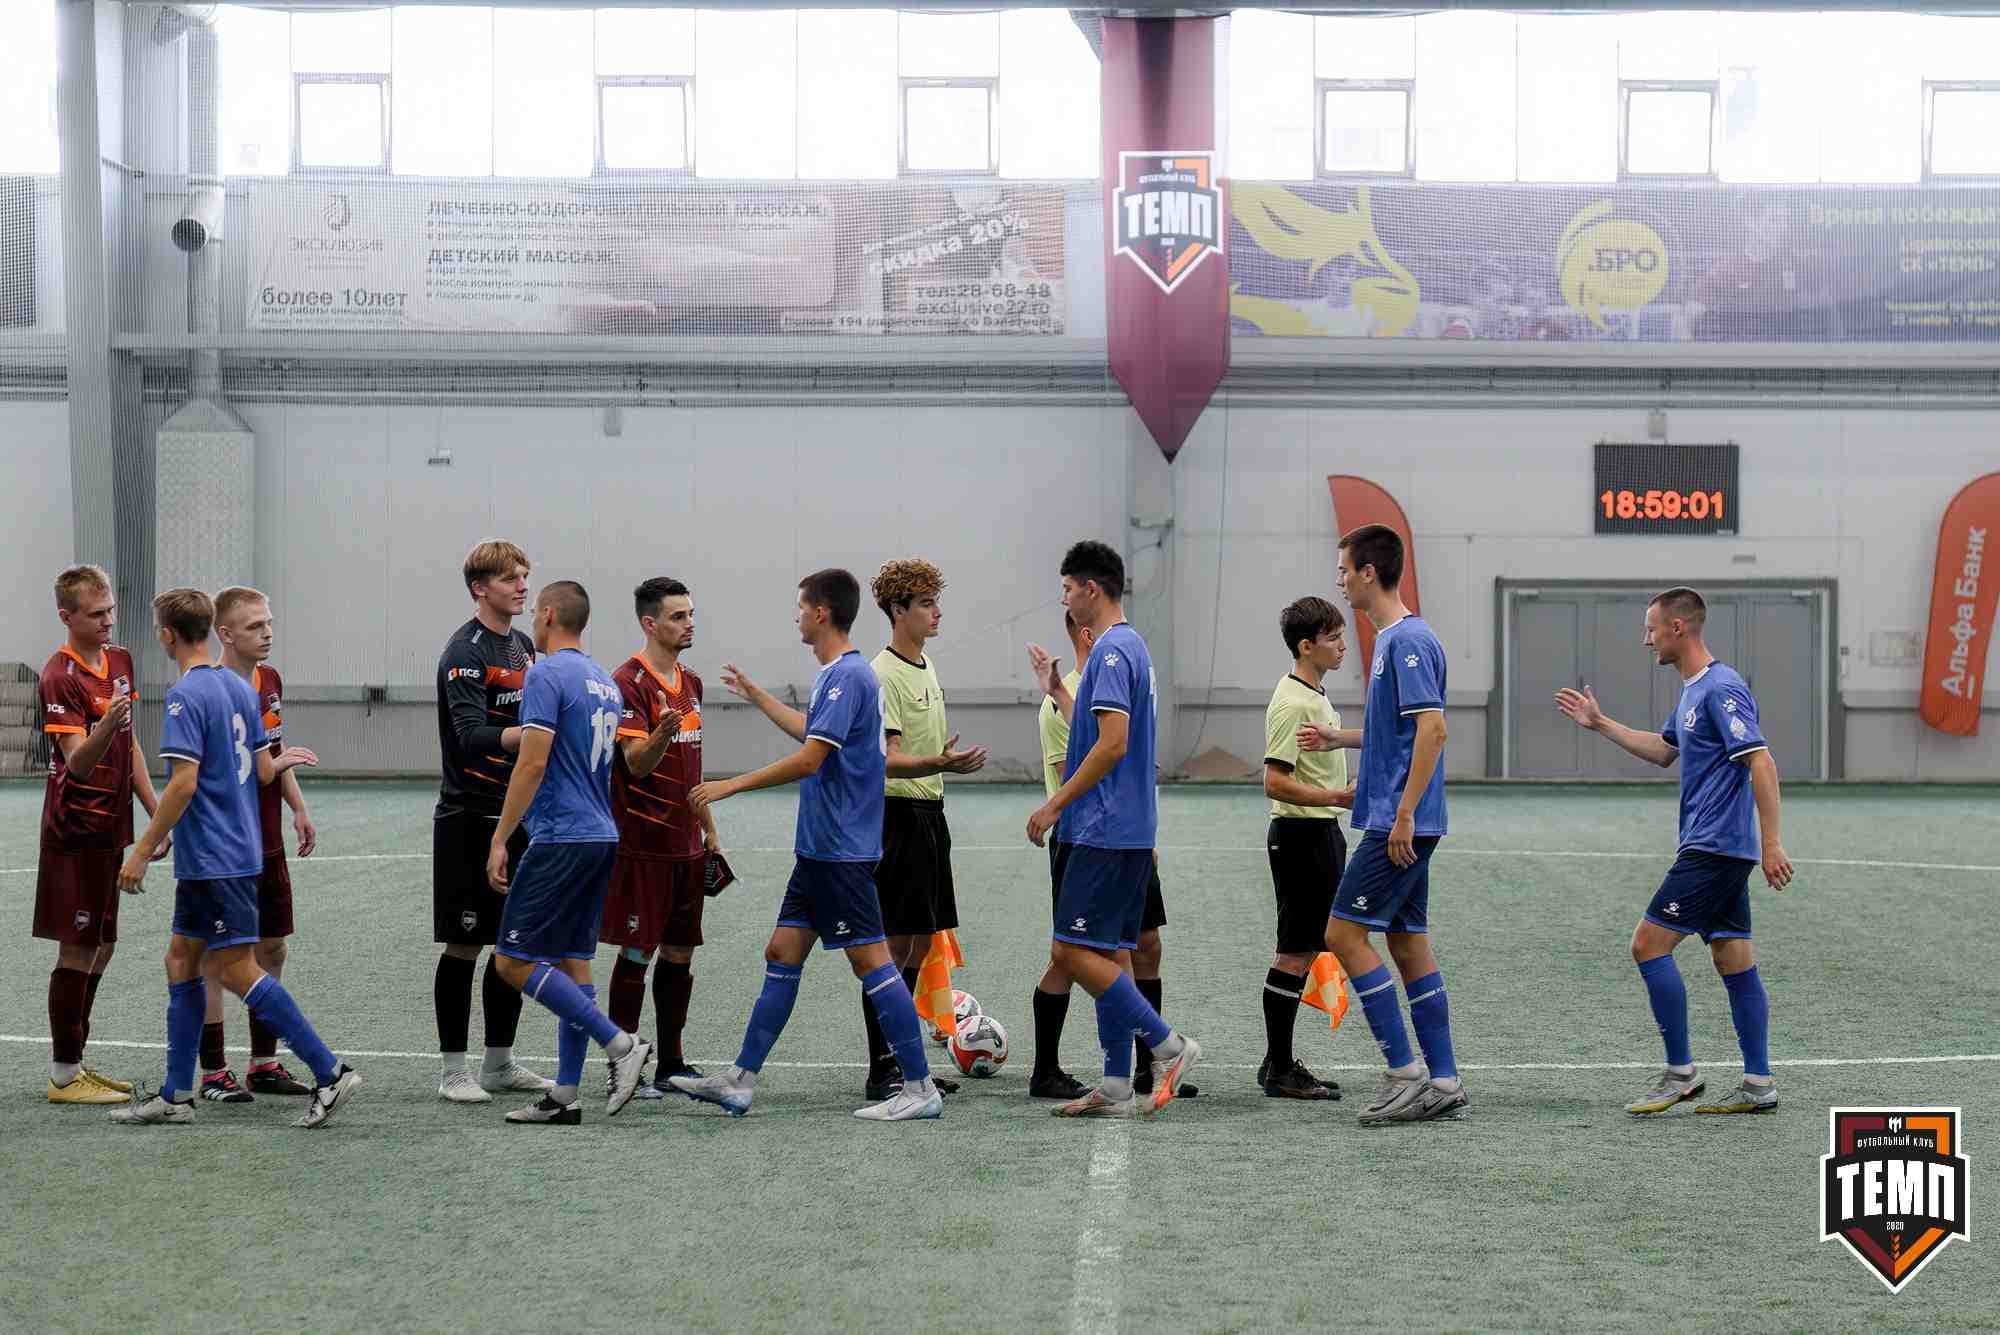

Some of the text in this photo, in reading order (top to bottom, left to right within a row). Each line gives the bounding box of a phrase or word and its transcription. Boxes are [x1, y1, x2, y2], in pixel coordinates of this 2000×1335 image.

[1124, 191, 1212, 240] ТЕМП
[289, 237, 384, 252] ЭКСКЛЮЗИВ
[428, 247, 519, 264] ДЕТСКИЙ
[869, 211, 1030, 275] скидка 20%
[262, 286, 408, 306] более 10лет
[1601, 490, 1723, 519] 18:59:01
[1941, 526, 1987, 697] Альфа Банк
[232, 713, 252, 785] 3
